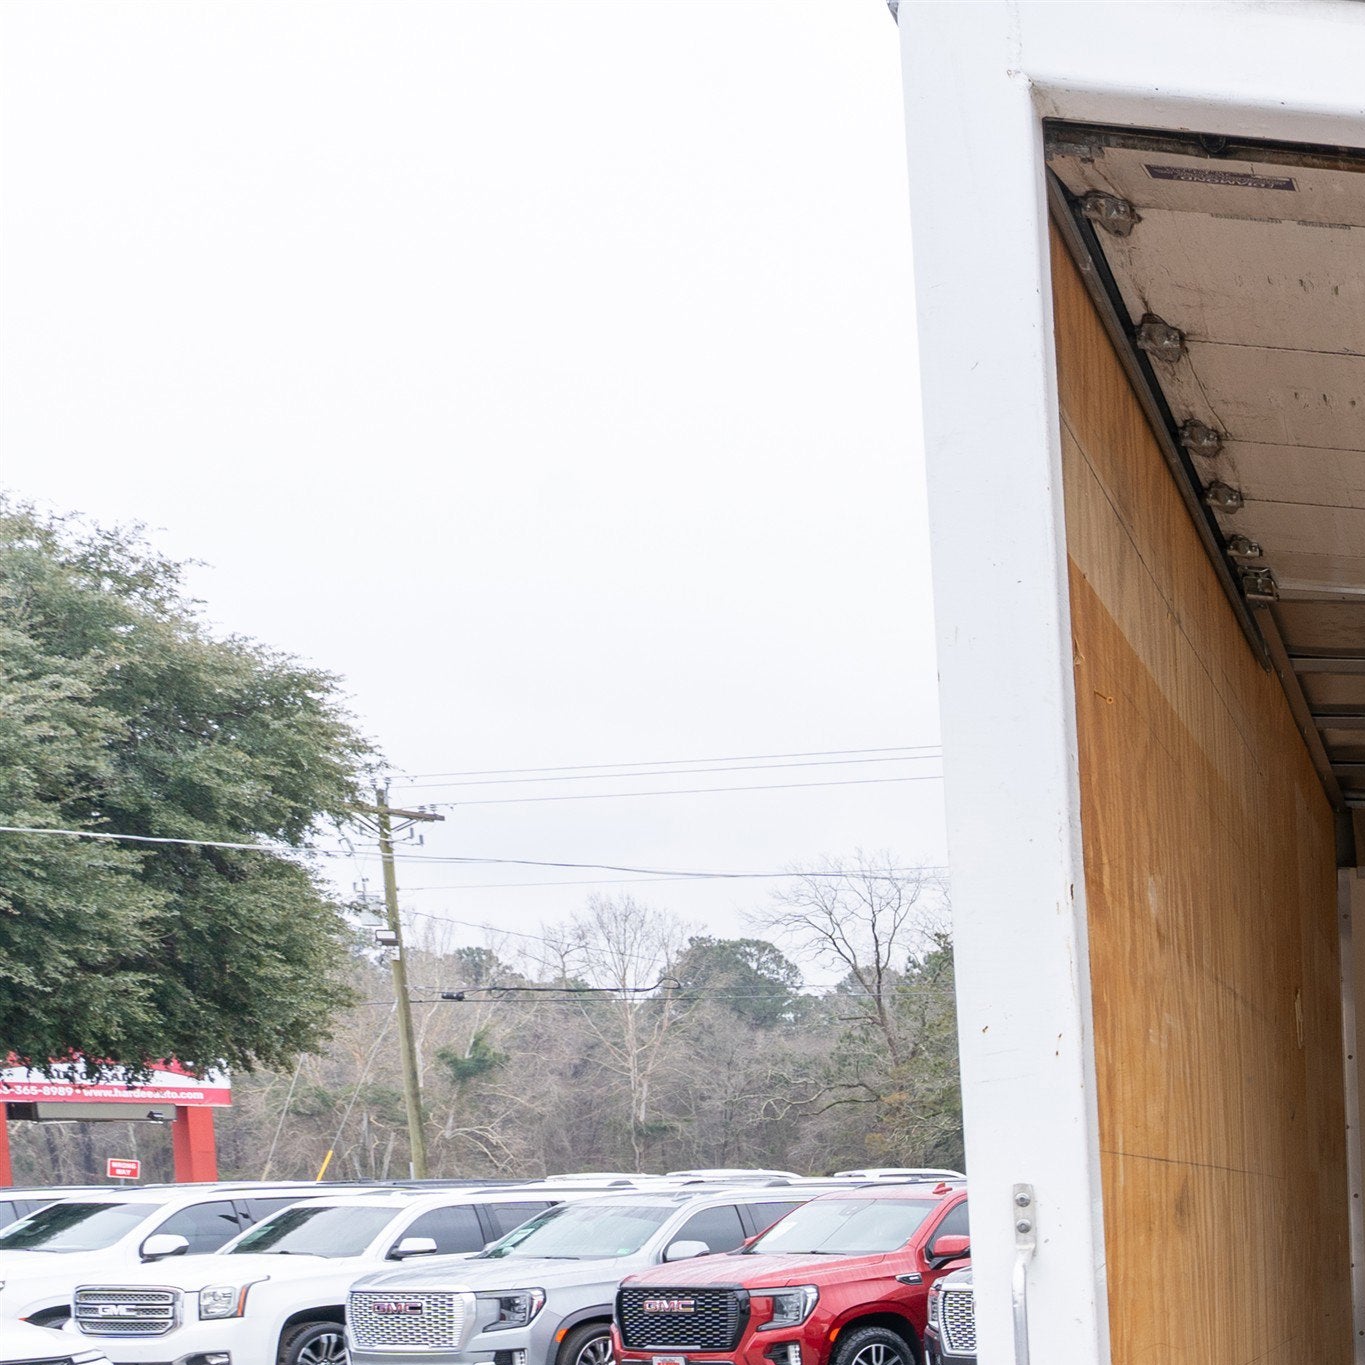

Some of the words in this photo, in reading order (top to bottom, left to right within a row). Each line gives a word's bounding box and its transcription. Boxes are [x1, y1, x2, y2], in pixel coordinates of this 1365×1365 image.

[0, 1085, 74, 1096] 3-365-8989
[98, 1304, 137, 1316] GMC
[372, 1301, 423, 1315] GMC
[643, 1299, 695, 1313] GMC
